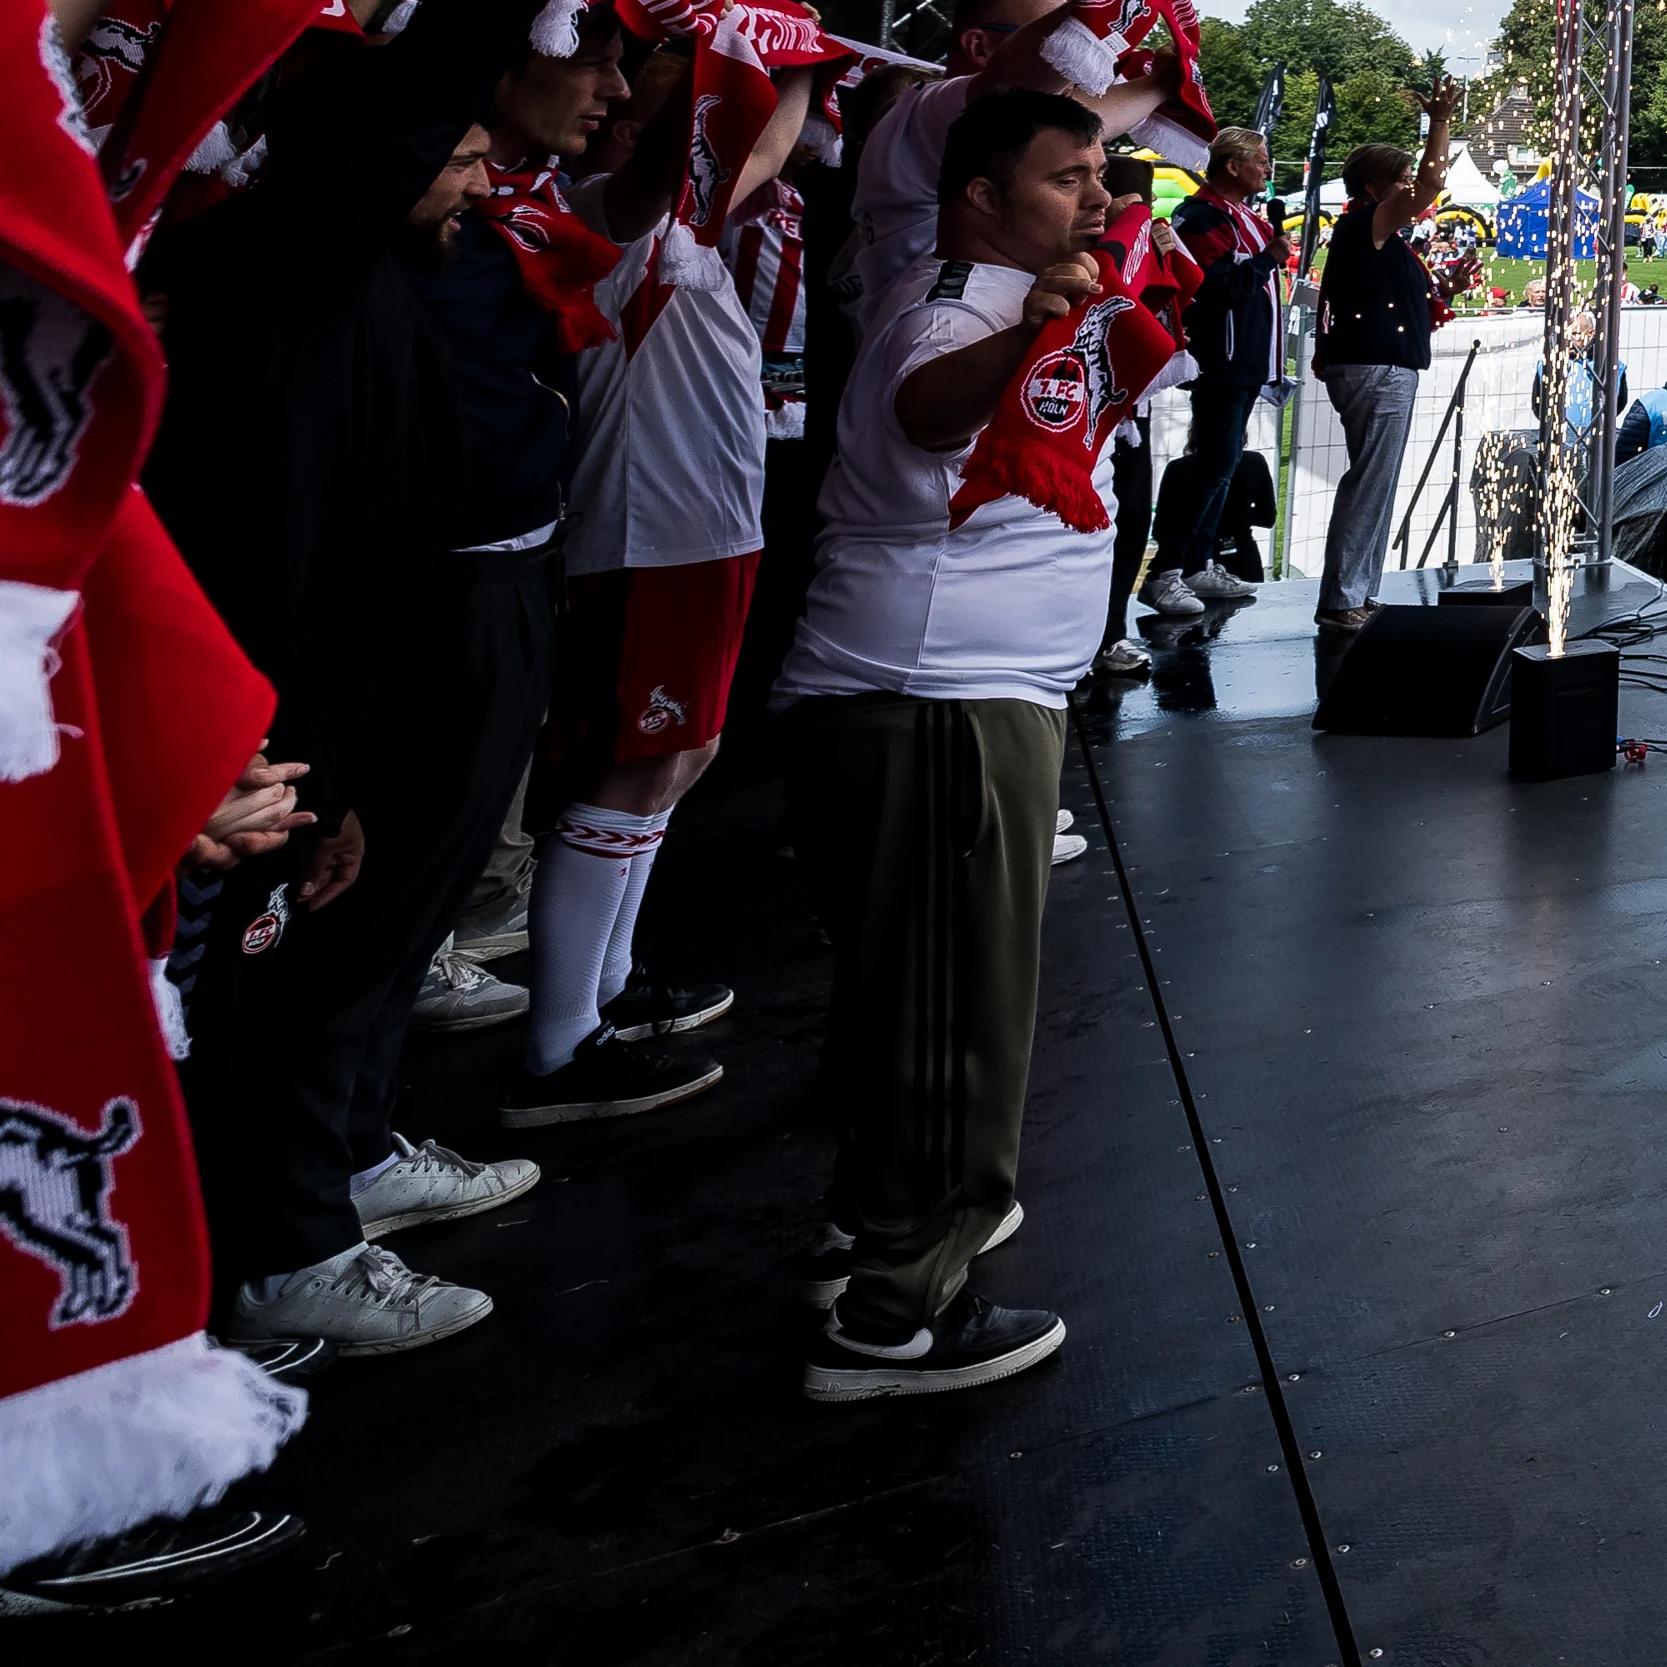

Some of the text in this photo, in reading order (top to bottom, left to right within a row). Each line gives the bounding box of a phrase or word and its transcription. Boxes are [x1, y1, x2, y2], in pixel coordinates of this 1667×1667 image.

[1039, 380, 1079, 398] 1. FC
[1038, 397, 1070, 418] KÖLN
